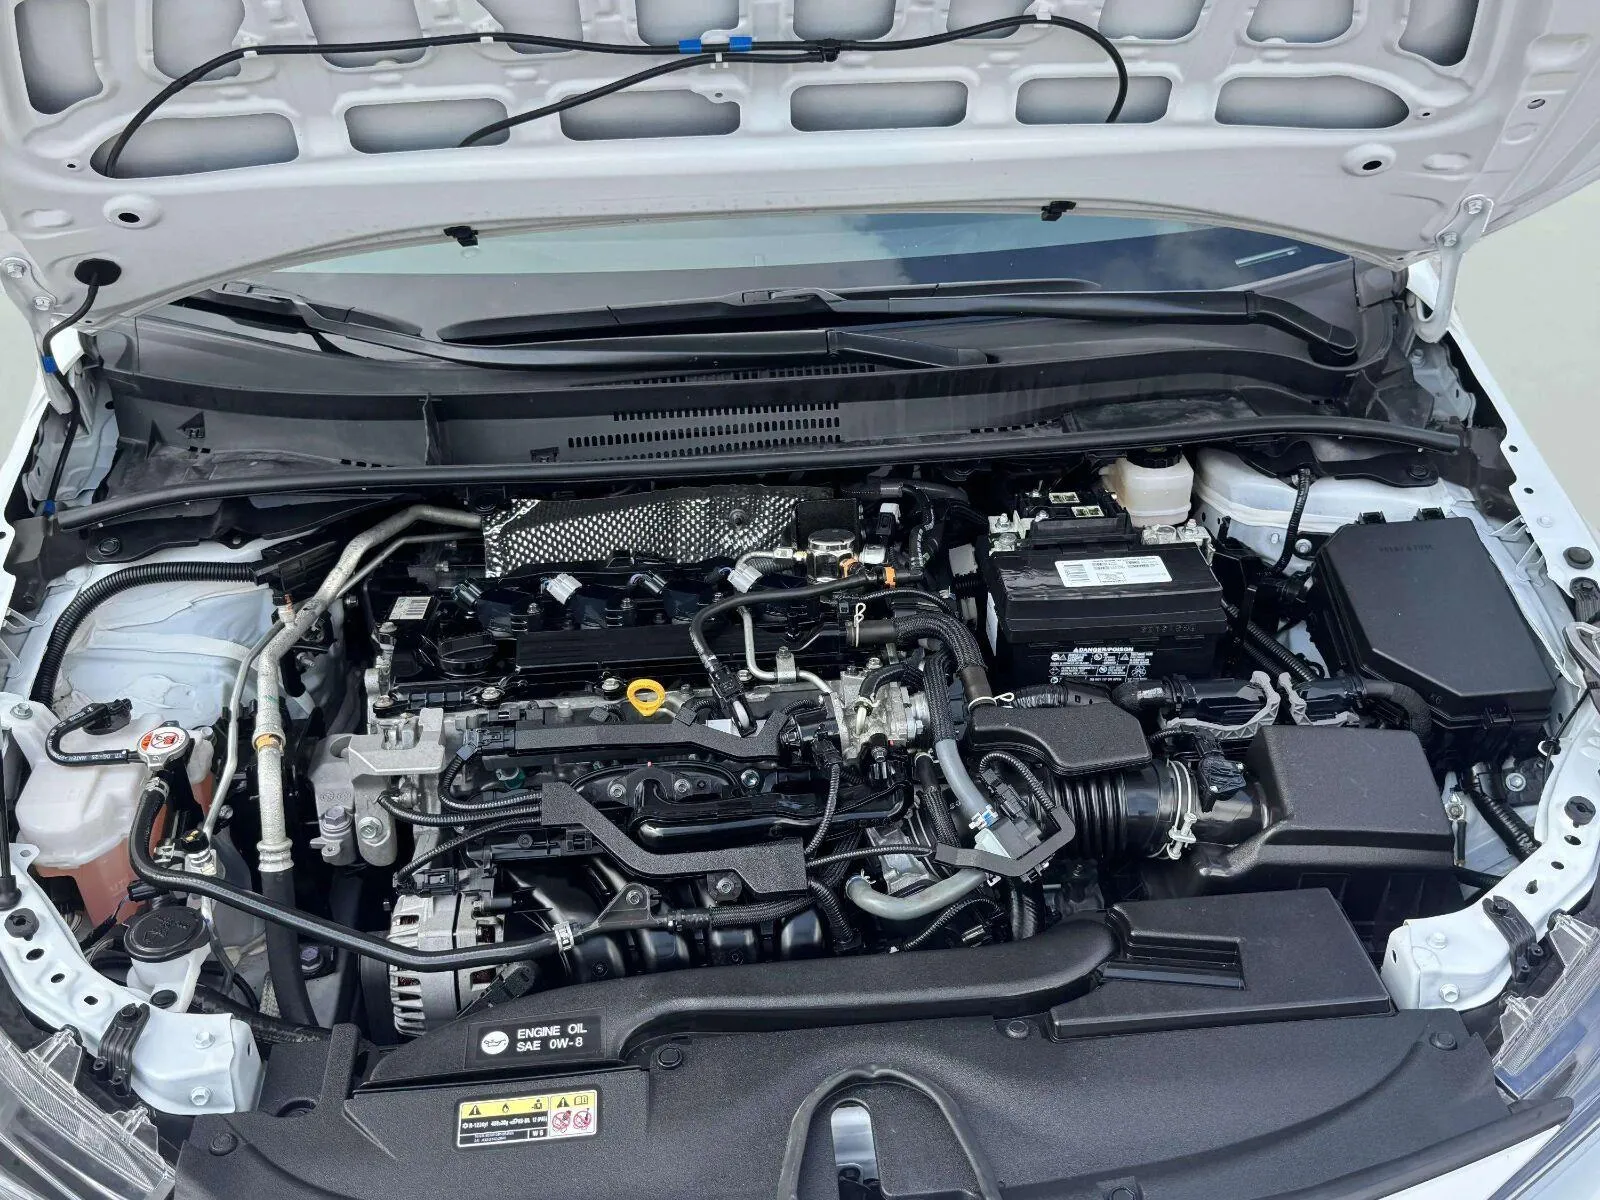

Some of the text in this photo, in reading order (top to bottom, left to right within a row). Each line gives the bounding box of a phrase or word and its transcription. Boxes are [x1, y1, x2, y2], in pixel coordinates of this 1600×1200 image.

[517, 1023, 588, 1039] ENGINE OIL
[516, 1036, 584, 1052] SAE 0W-8
